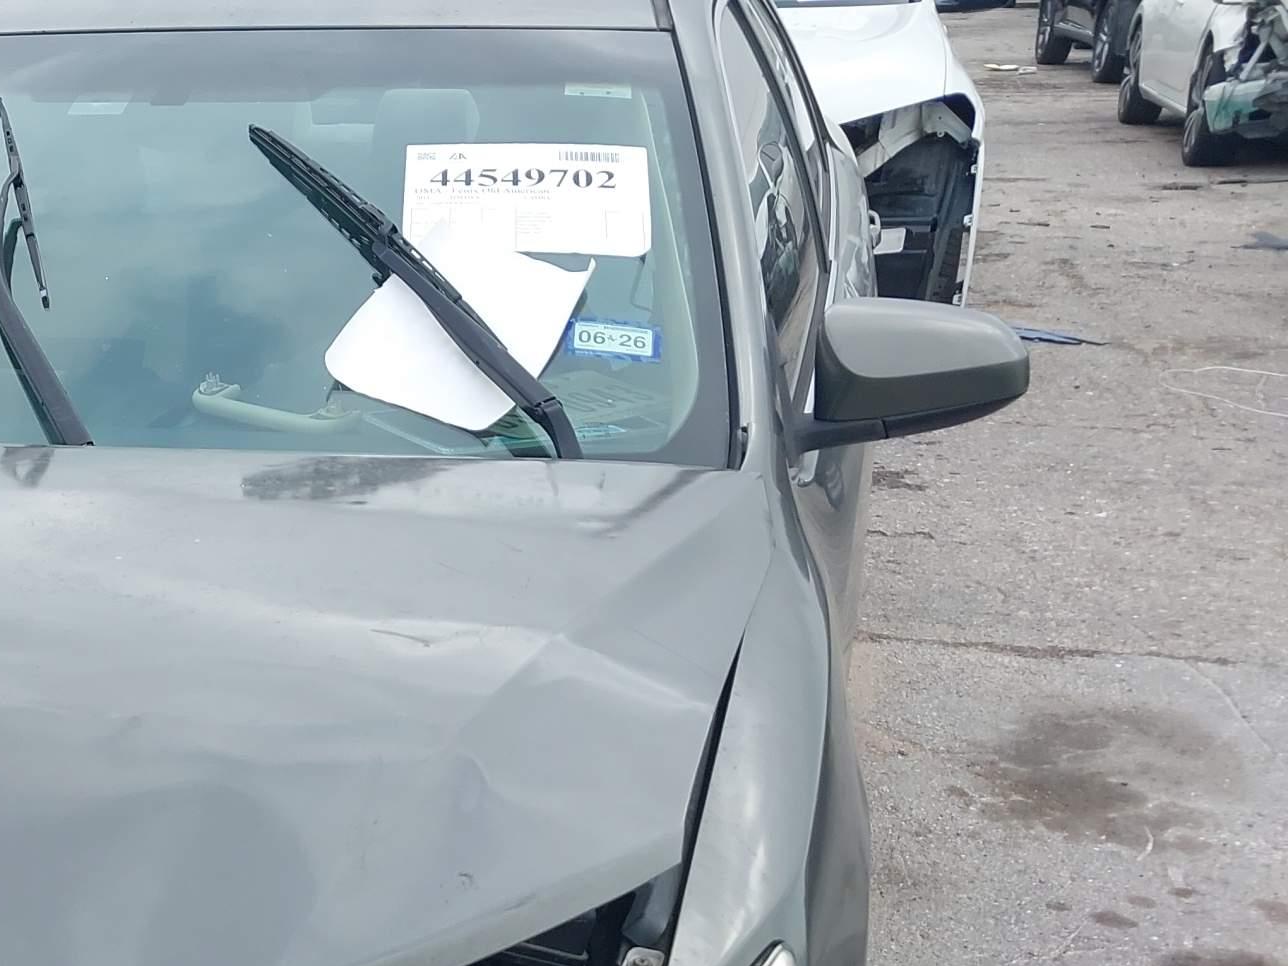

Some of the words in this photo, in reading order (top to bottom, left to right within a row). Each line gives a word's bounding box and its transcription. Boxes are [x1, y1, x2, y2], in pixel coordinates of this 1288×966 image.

[430, 168, 617, 189] 44549702
[578, 329, 606, 345] 06
[618, 333, 646, 349] 26
